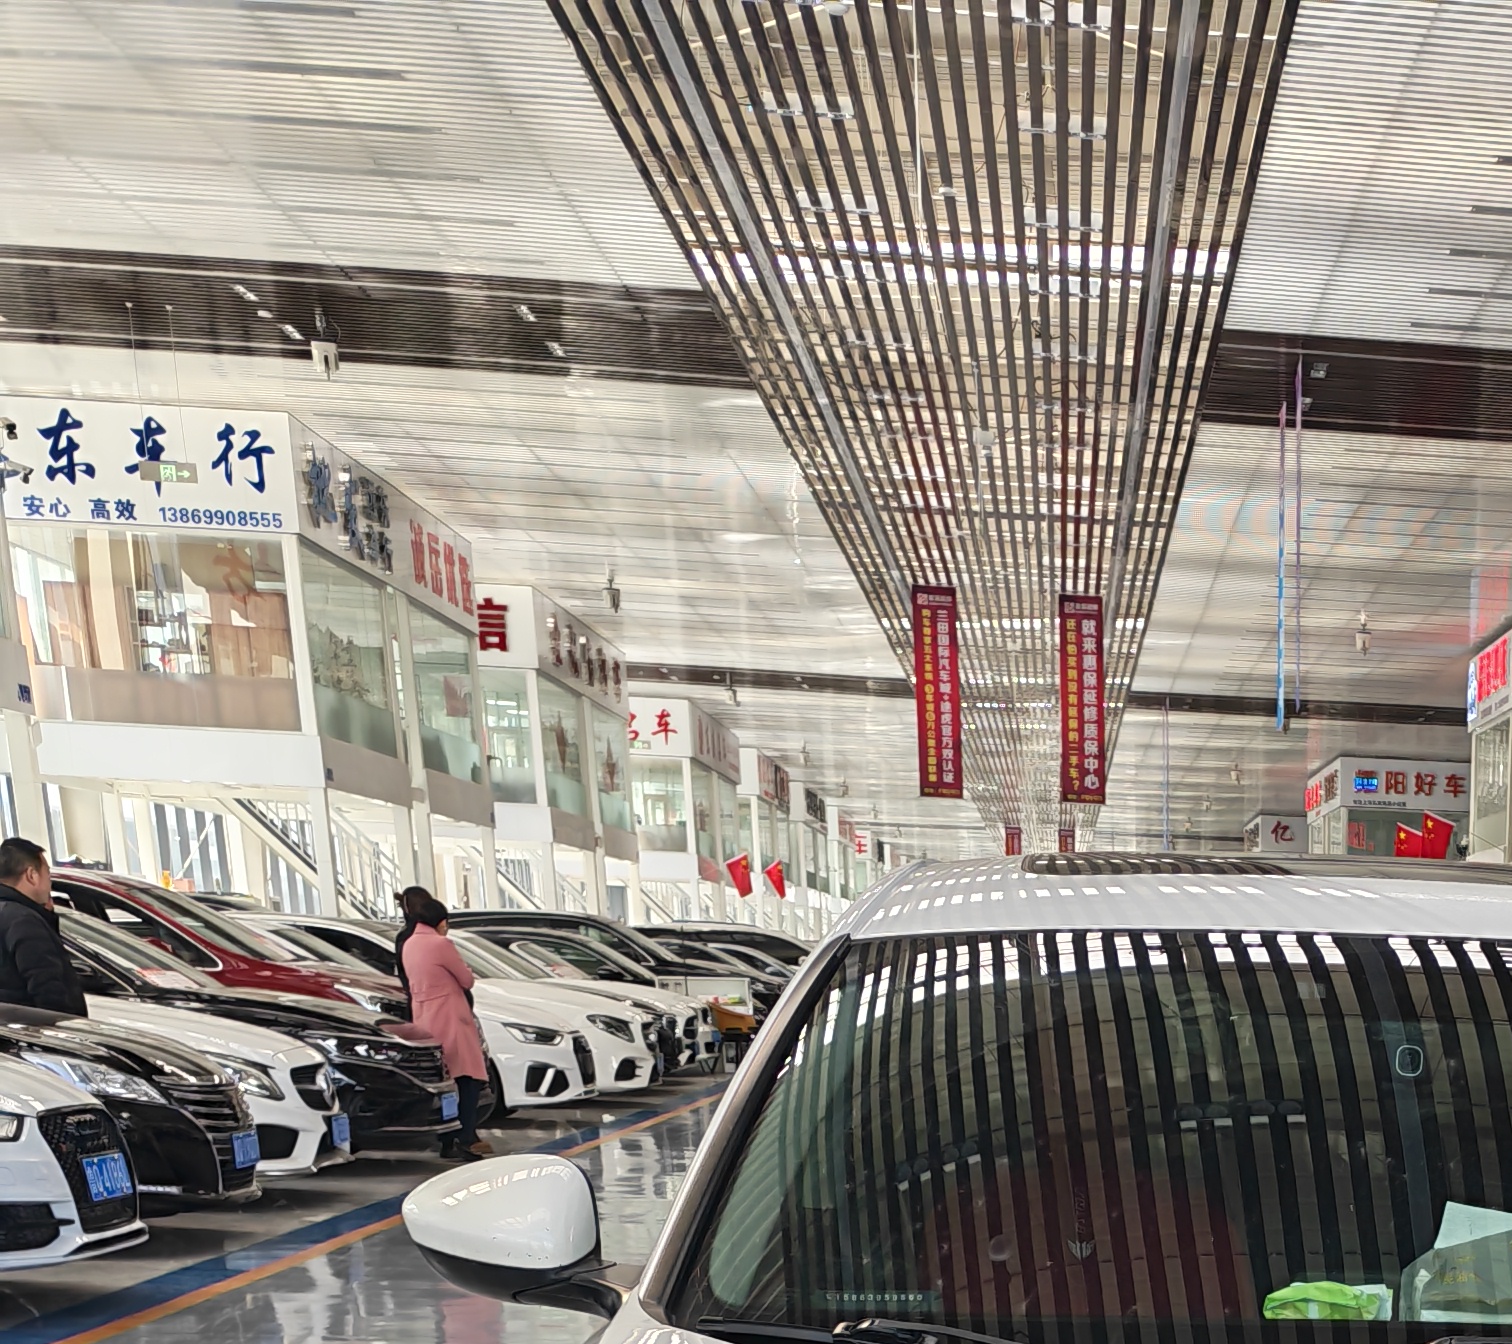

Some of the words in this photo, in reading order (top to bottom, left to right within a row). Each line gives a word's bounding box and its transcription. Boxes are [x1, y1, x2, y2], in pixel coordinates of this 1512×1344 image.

[0, 407, 276, 498] 东车行
[23, 495, 71, 518] 安心
[88, 498, 137, 521] 高效
[158, 507, 283, 528] 13869908555
